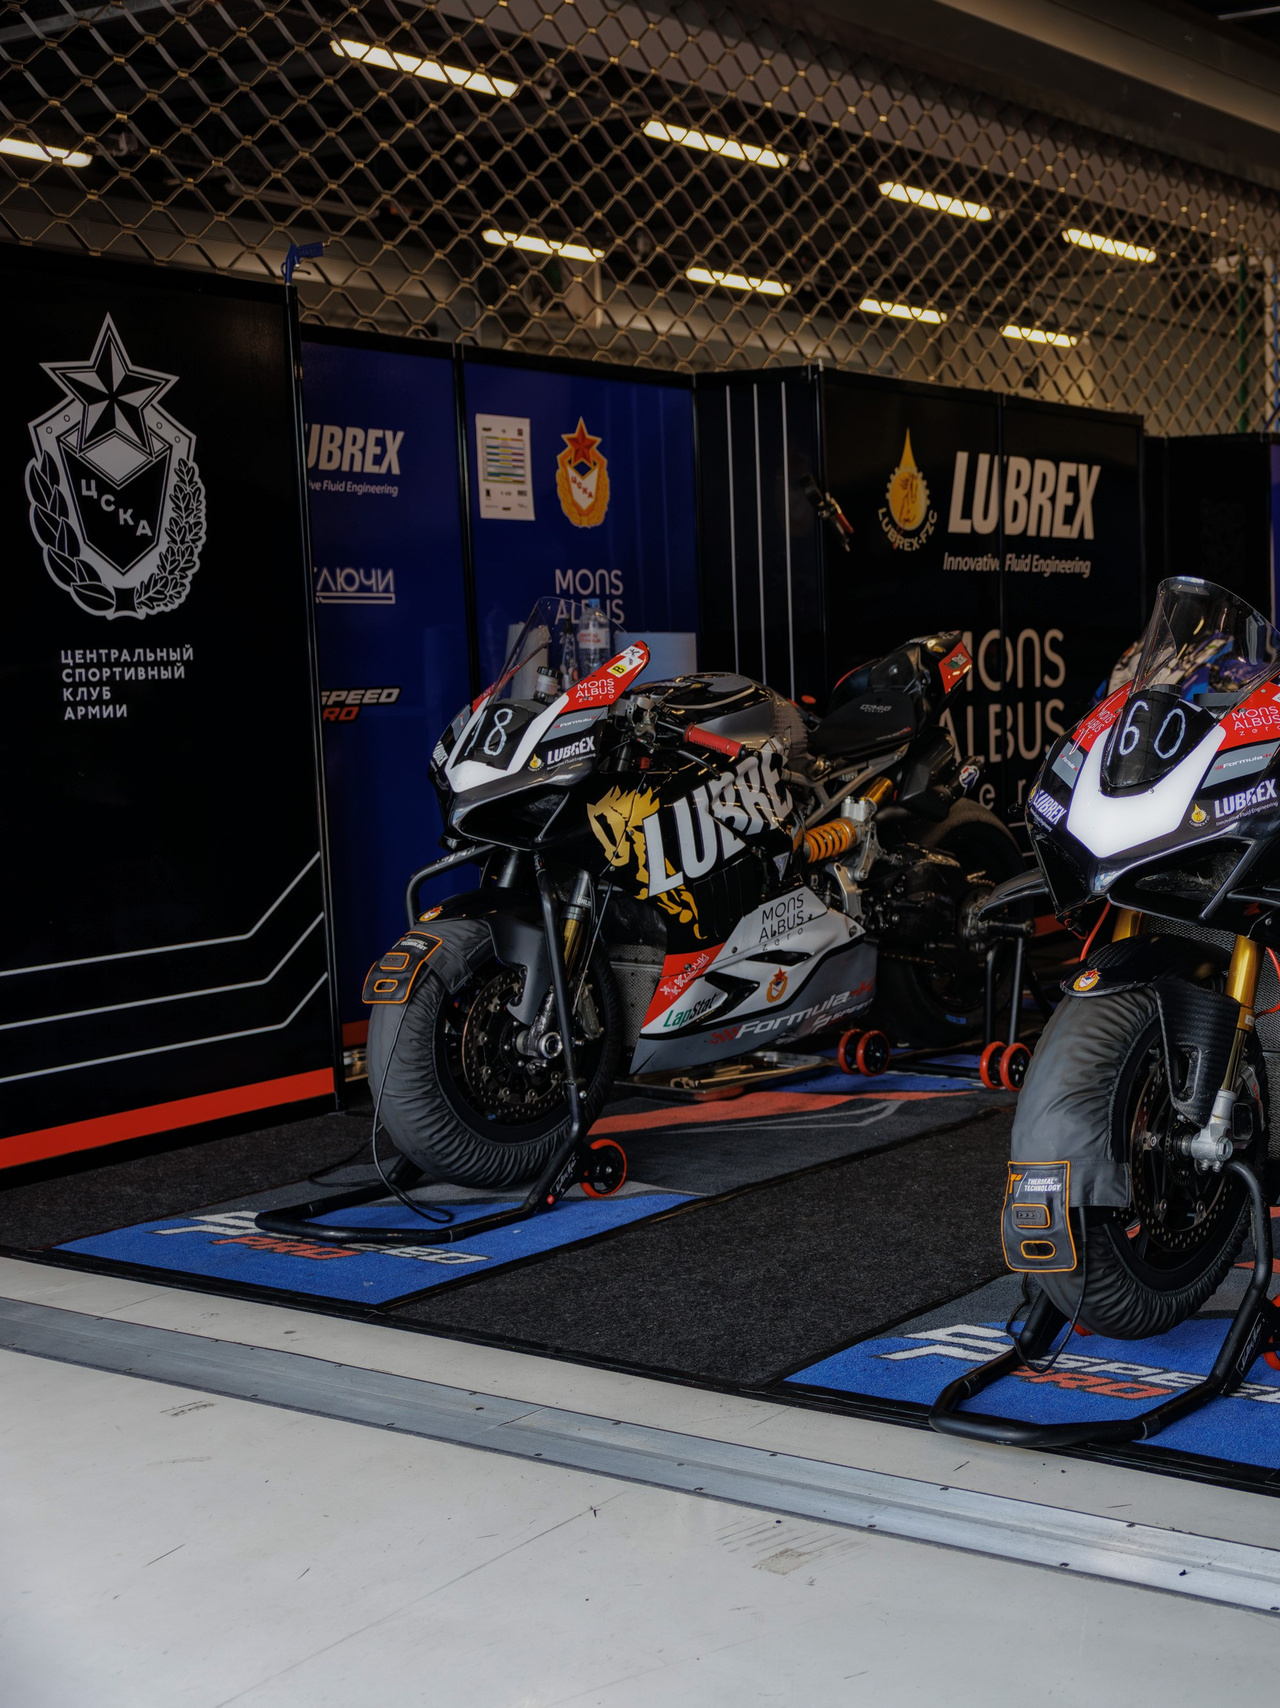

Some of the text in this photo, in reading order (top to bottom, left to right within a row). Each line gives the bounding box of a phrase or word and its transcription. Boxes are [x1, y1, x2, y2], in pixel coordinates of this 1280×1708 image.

[323, 479, 344, 493] Fluid
[346, 480, 399, 497] Engineering
[947, 450, 1102, 541] LUBREX
[81, 479, 153, 537] ЦСКА
[1005, 553, 1030, 573] Fluid
[1032, 554, 1092, 578] Engineering
[314, 567, 396, 593] ЛЮЧИ
[60, 644, 194, 666] ЦЕНТРАЛЬНЫЙ
[61, 664, 186, 683] СПОРТИВНЫЙ
[62, 686, 111, 702] КЛУБ
[575, 686, 615, 698] ALBUS
[63, 704, 128, 721] АРМИИ
[1231, 705, 1279, 721] MONS
[547, 735, 596, 765] LUBREX
[1213, 778, 1278, 819] LUBREX
[761, 892, 805, 925] MONS
